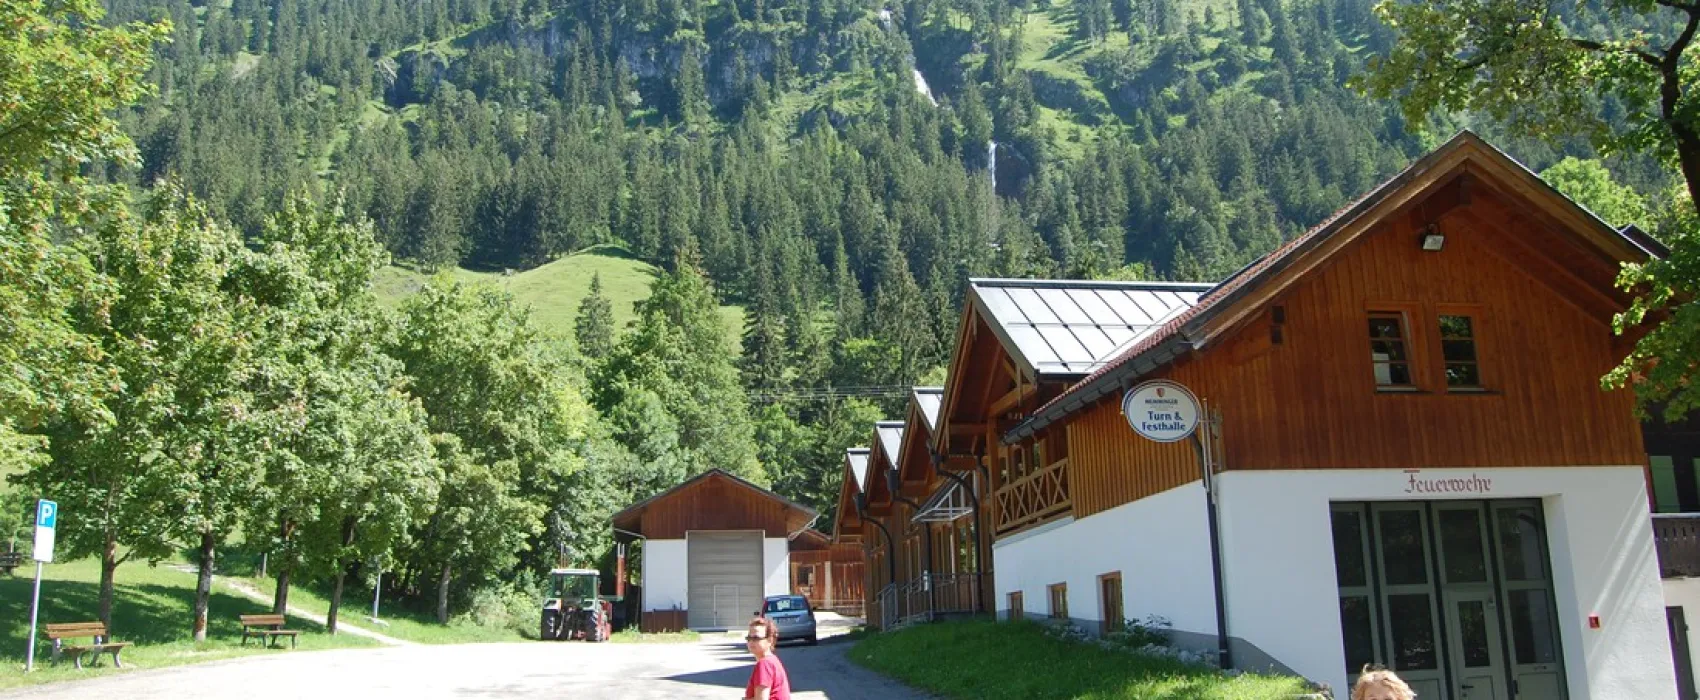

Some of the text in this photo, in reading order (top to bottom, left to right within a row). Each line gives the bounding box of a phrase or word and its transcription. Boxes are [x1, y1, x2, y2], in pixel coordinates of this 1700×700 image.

[1147, 411, 1184, 421] Turn &
[1142, 422, 1186, 431] Festhalle
[1403, 468, 1491, 493] Feuerwehr
[41, 503, 53, 525] P
